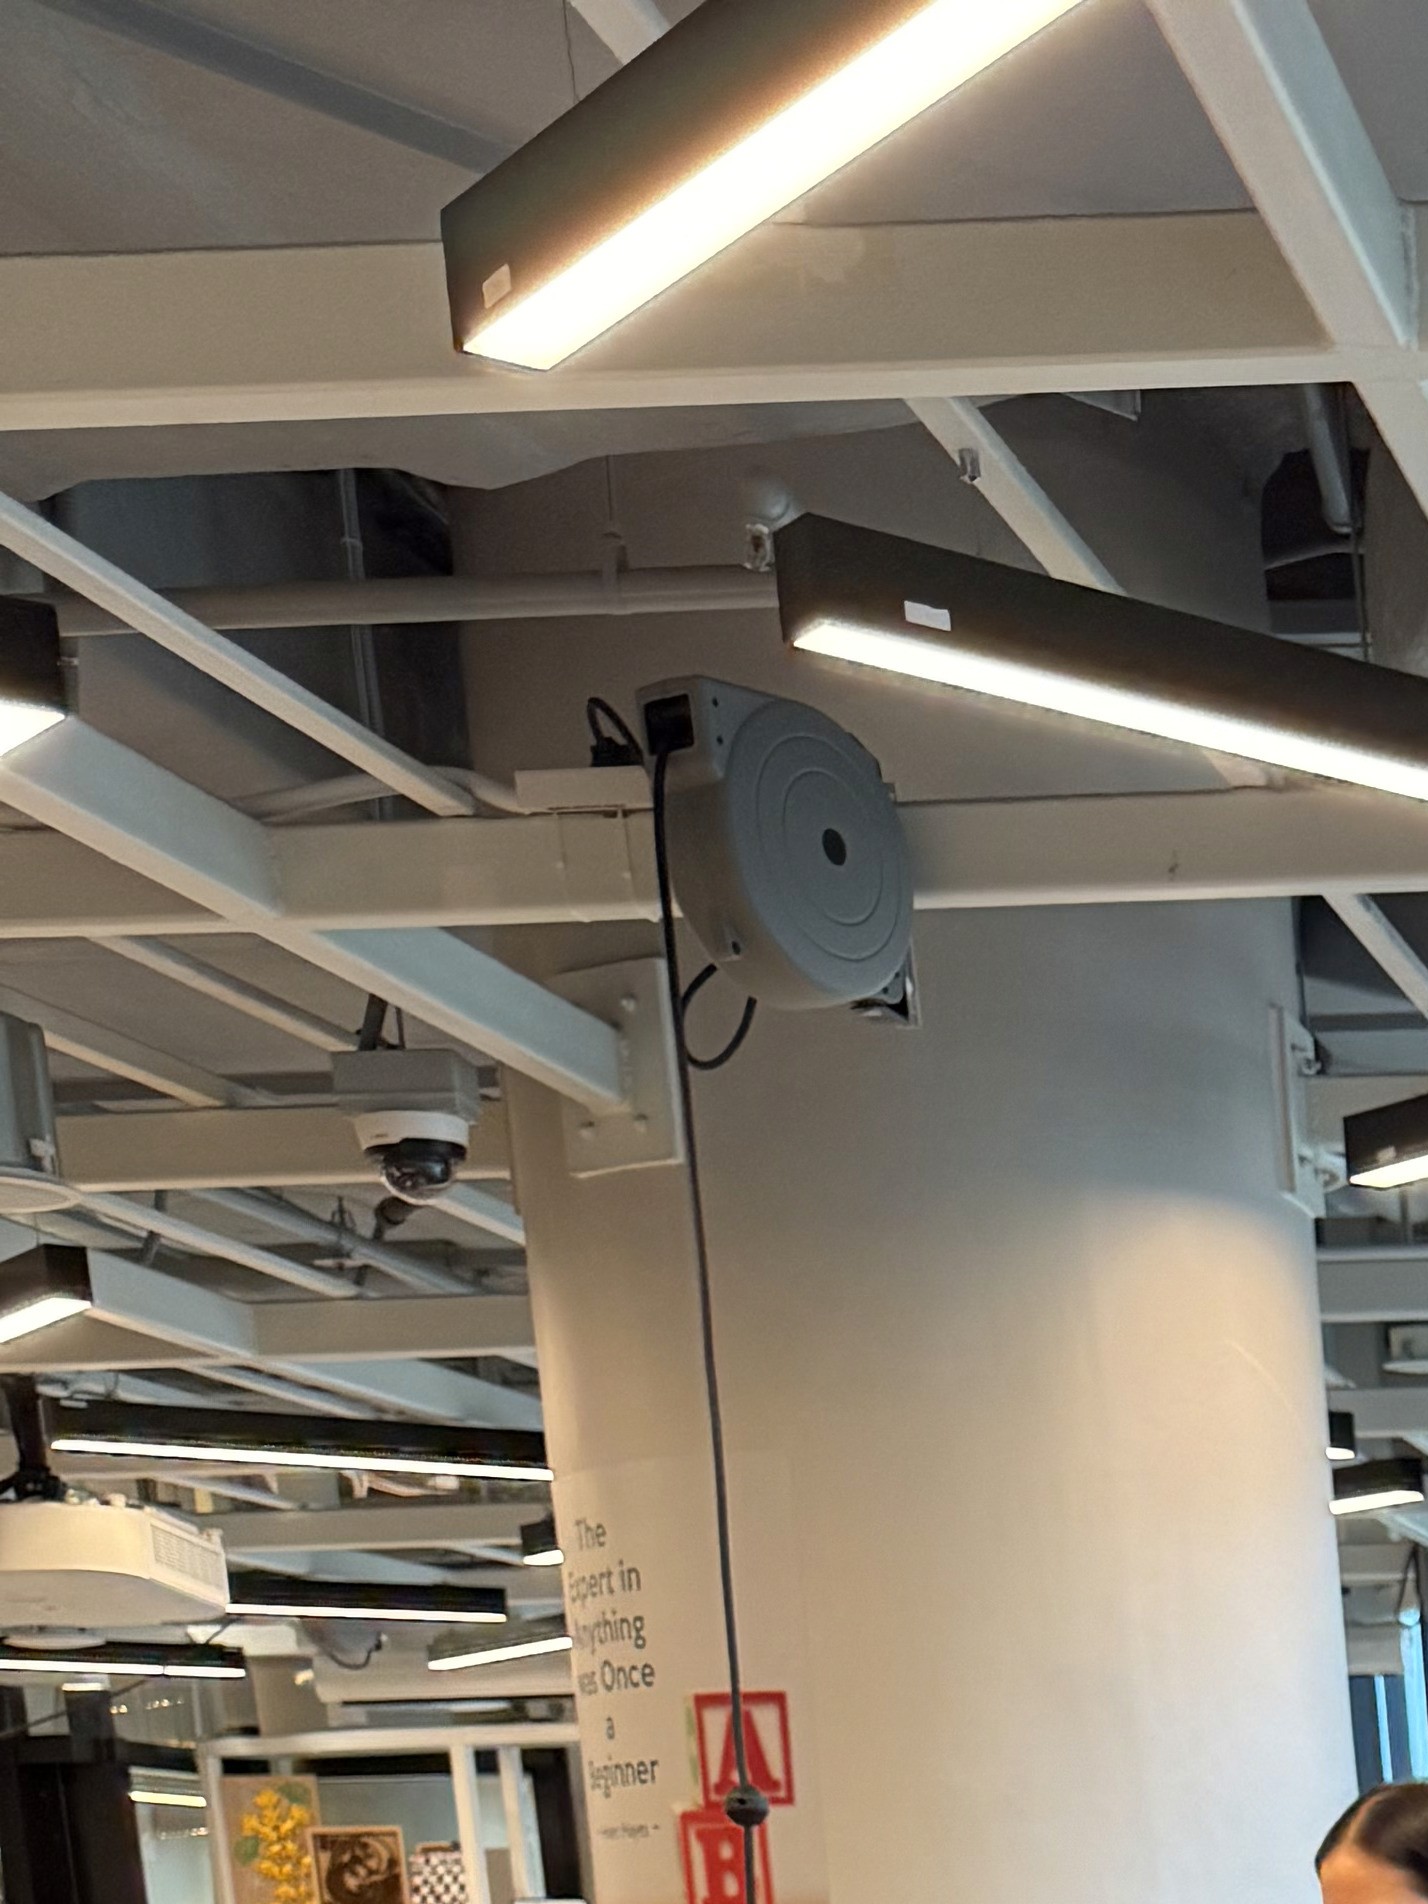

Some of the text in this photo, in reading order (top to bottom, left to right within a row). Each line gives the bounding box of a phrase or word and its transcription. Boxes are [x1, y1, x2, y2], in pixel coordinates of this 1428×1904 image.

[576, 1519, 607, 1549] The
[618, 1560, 642, 1593] in
[600, 1659, 656, 1692] Once
[605, 1715, 616, 1740] a
